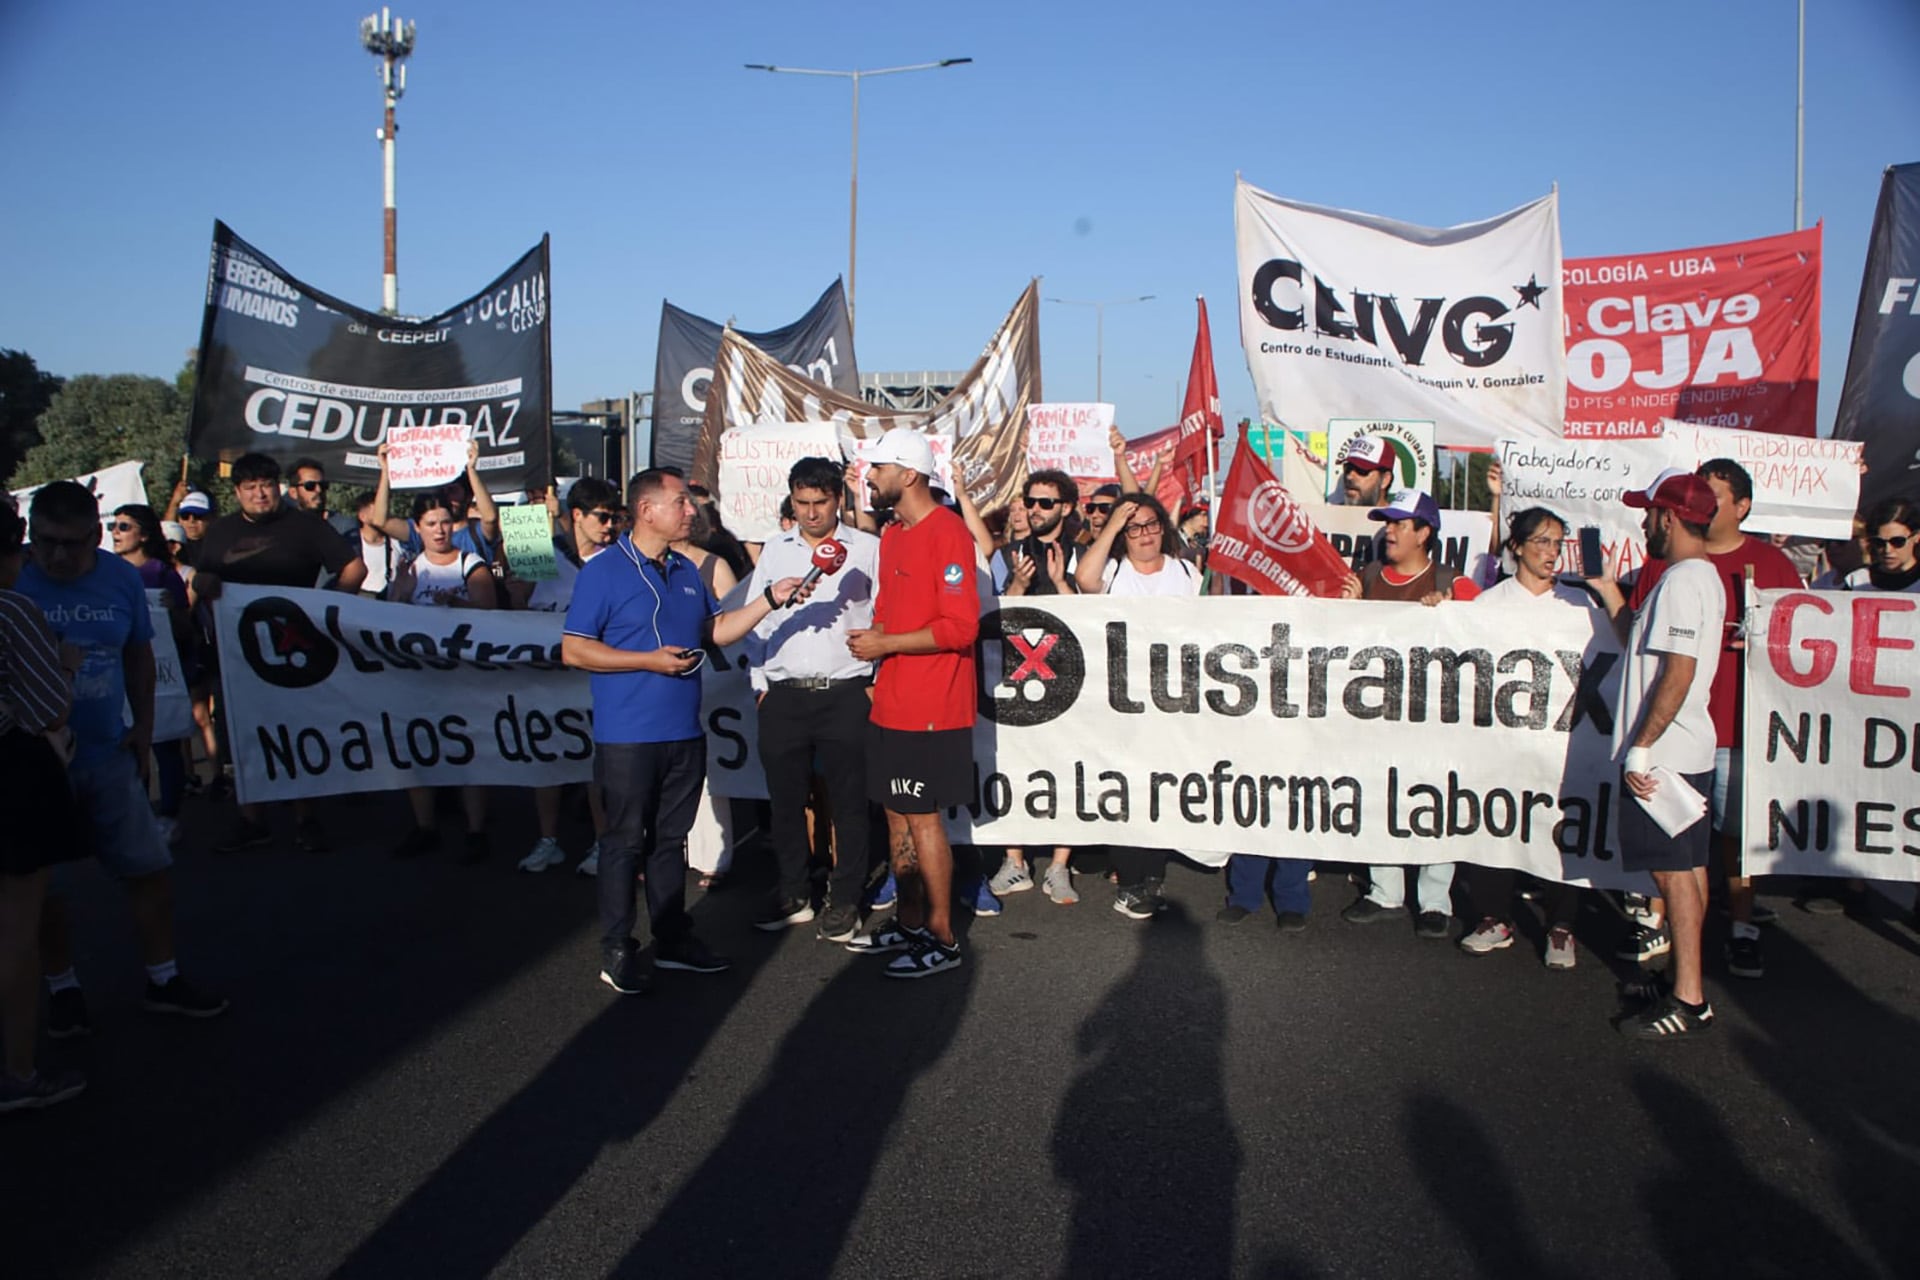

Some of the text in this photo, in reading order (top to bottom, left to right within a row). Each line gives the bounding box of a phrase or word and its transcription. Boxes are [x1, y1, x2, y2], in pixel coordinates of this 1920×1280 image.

[1669, 257, 1716, 277] UBA
[1878, 278, 1920, 314] F
[1587, 293, 1760, 336] Clave
[1260, 341, 1302, 355] Centro
[1306, 345, 1322, 357] de
[1325, 348, 1395, 369] Estudiant
[1466, 377, 1479, 390] V.
[1483, 373, 1545, 389] González
[1567, 326, 1763, 393] OJA
[265, 372, 509, 402] Centros de estudiantes departamentales
[1584, 396, 1614, 409] PTS
[1631, 381, 1768, 409] INDEPENDIENTES
[1367, 421, 1395, 433] SALUD
[1652, 422, 1664, 435] d
[1501, 439, 1612, 475] Trabajadorxs
[44, 603, 115, 624] dyGraf
[257, 694, 748, 780] No a los dess
[1767, 710, 1920, 773] NI D
[890, 777, 925, 798] NIKE
[1024, 770, 1057, 819] a
[1075, 760, 1129, 823] la
[1149, 760, 1361, 837] reforma
[1387, 766, 1613, 861] laboral
[1768, 799, 1829, 851] NI
